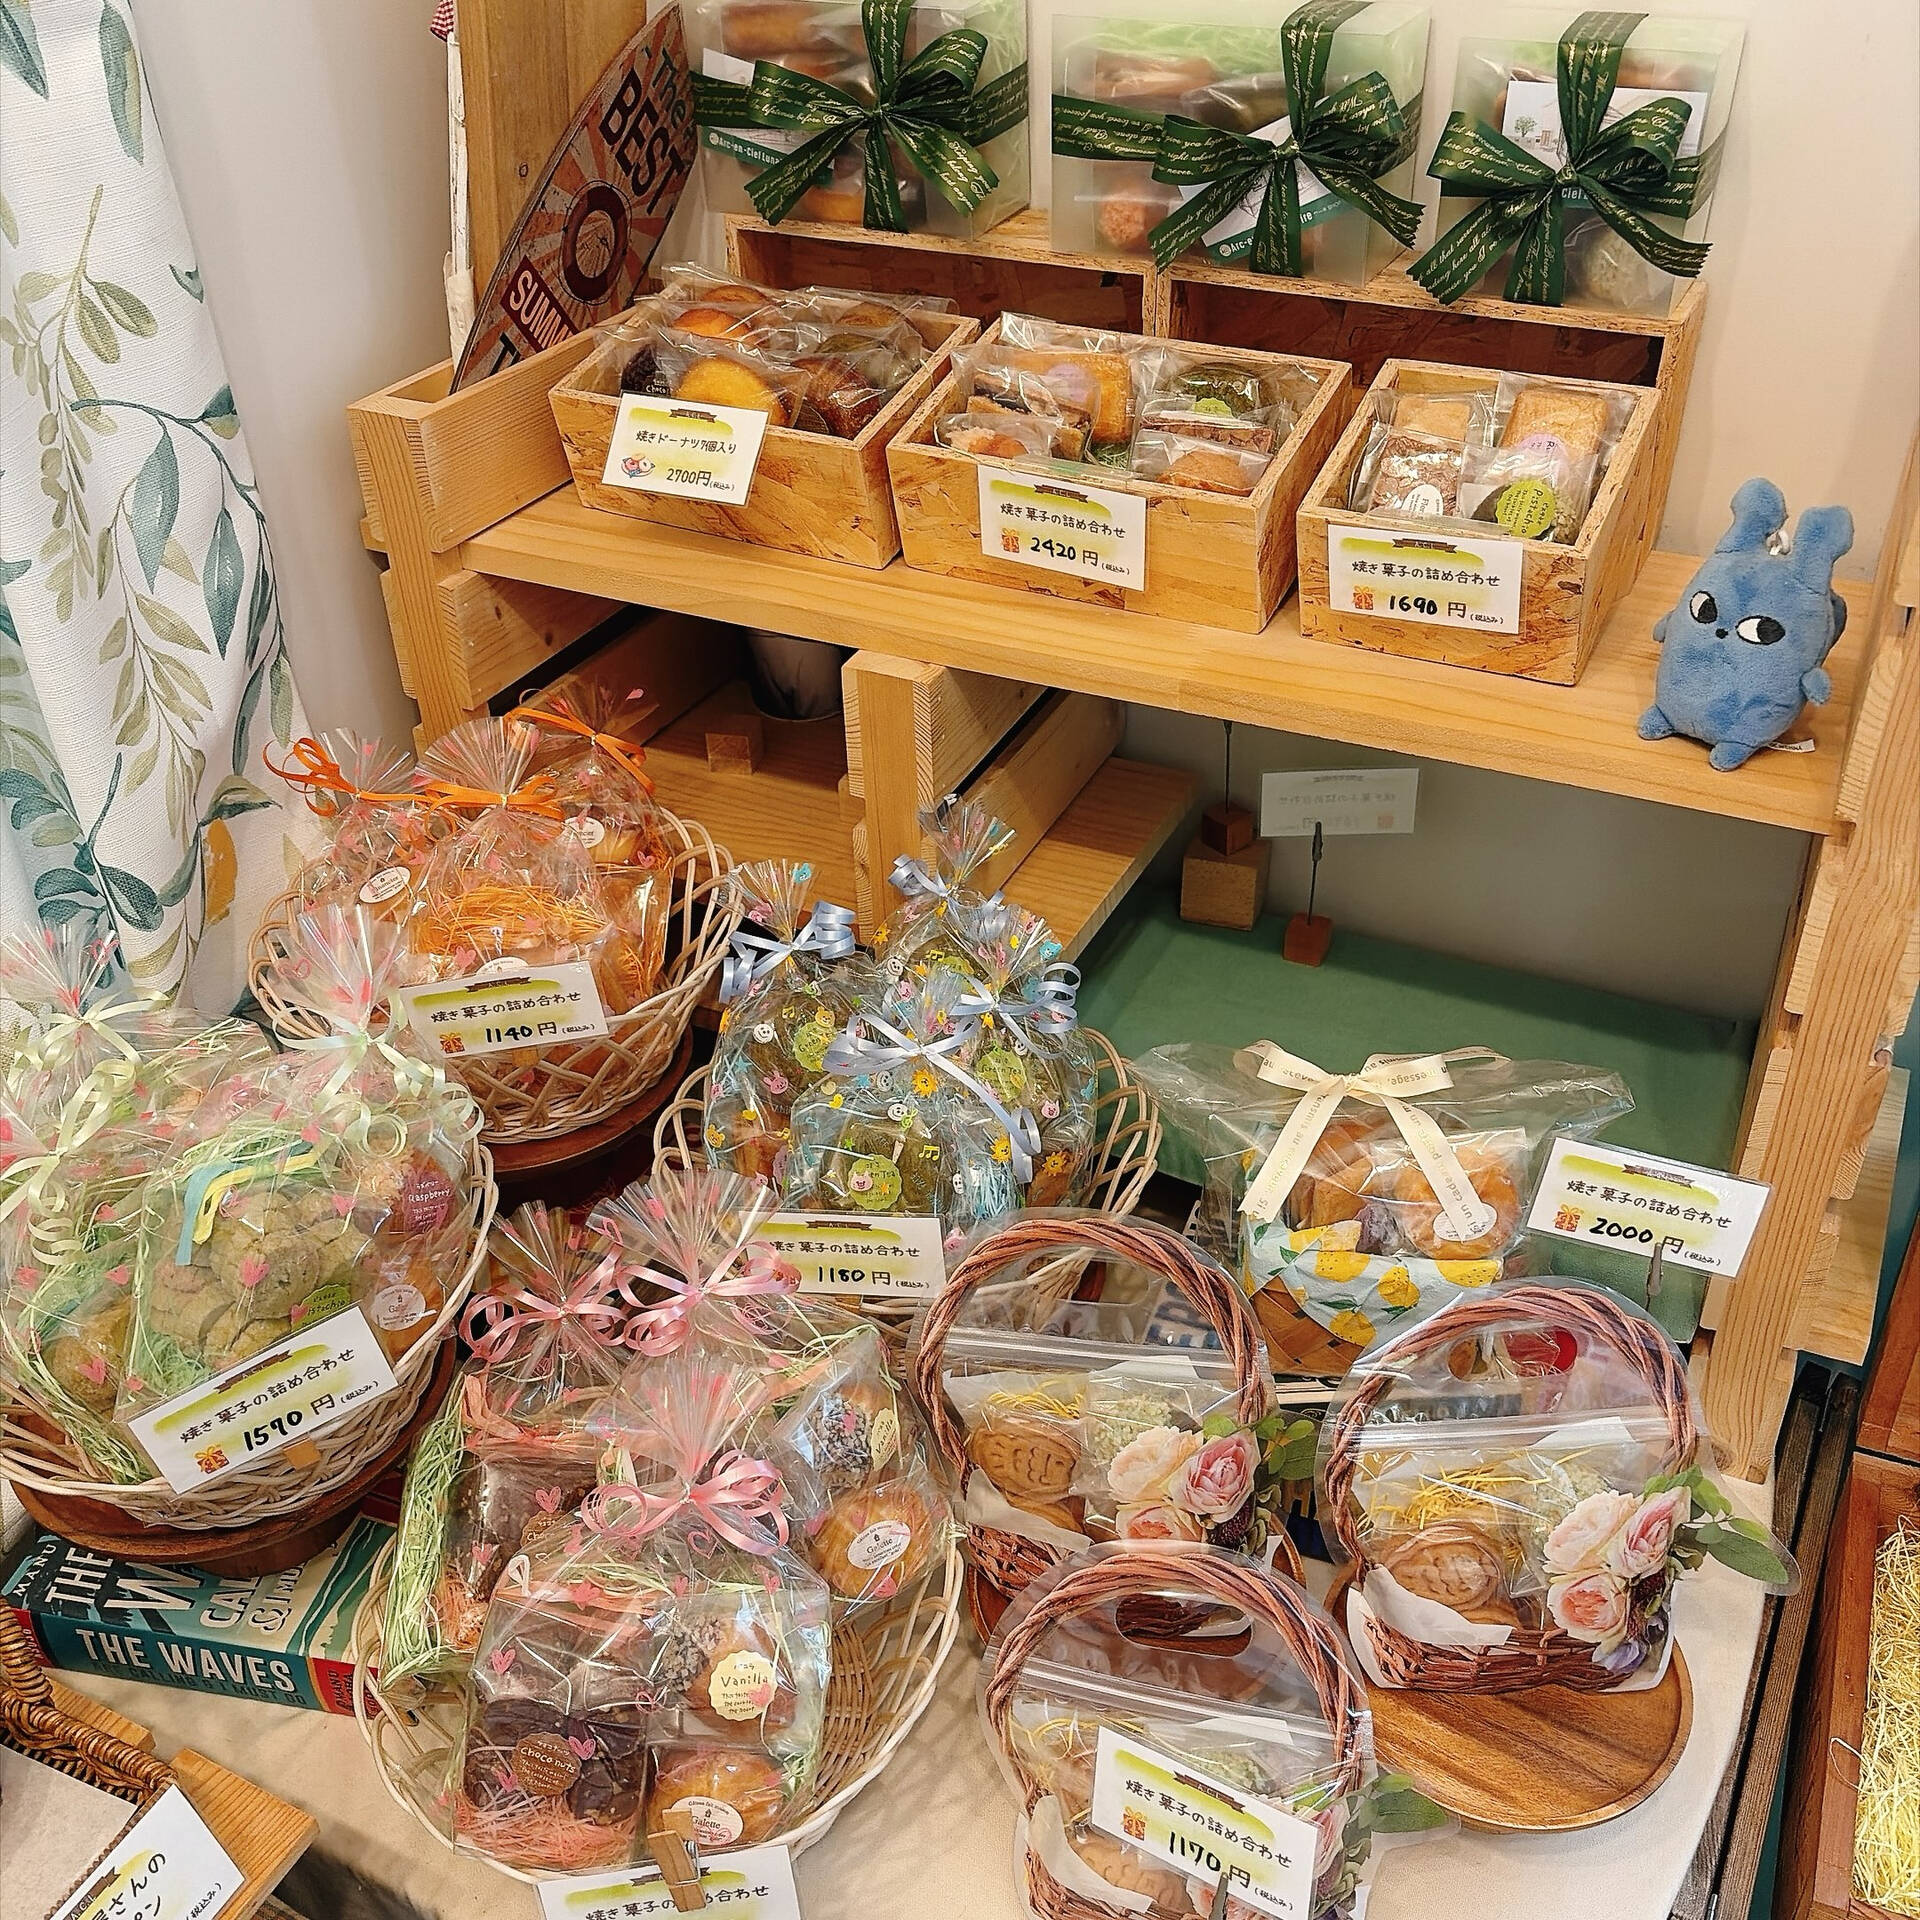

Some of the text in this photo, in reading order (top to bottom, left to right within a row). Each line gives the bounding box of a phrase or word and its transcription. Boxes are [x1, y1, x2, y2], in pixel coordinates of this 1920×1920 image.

[599, 66, 690, 215] BEST
[1561, 187, 1582, 200] Ciel
[636, 430, 737, 455] 焼きドーナツ7個入り
[666, 470, 712, 487] 2700円
[1000, 503, 1126, 539] 焼き菓子の詰め合わせ
[1519, 487, 1547, 535] Pistachio
[1351, 561, 1501, 587] 焼き菓子の詰め合わせ
[431, 992, 581, 1023] 焼き菓子の詰め合わせ
[408, 1189, 450, 1203] Raspberry
[1566, 1179, 1732, 1229] 焼き菓子の詰め合わせ
[180, 1349, 355, 1443] 焼き菓子の詰め合わせ
[45, 1547, 114, 1604] THE
[76, 1628, 151, 1668] THE
[158, 1640, 295, 1693] WAVES
[721, 1672, 769, 1688] Vanilla
[1125, 1779, 1292, 1869] 焼き菓子の詰め合わせ
